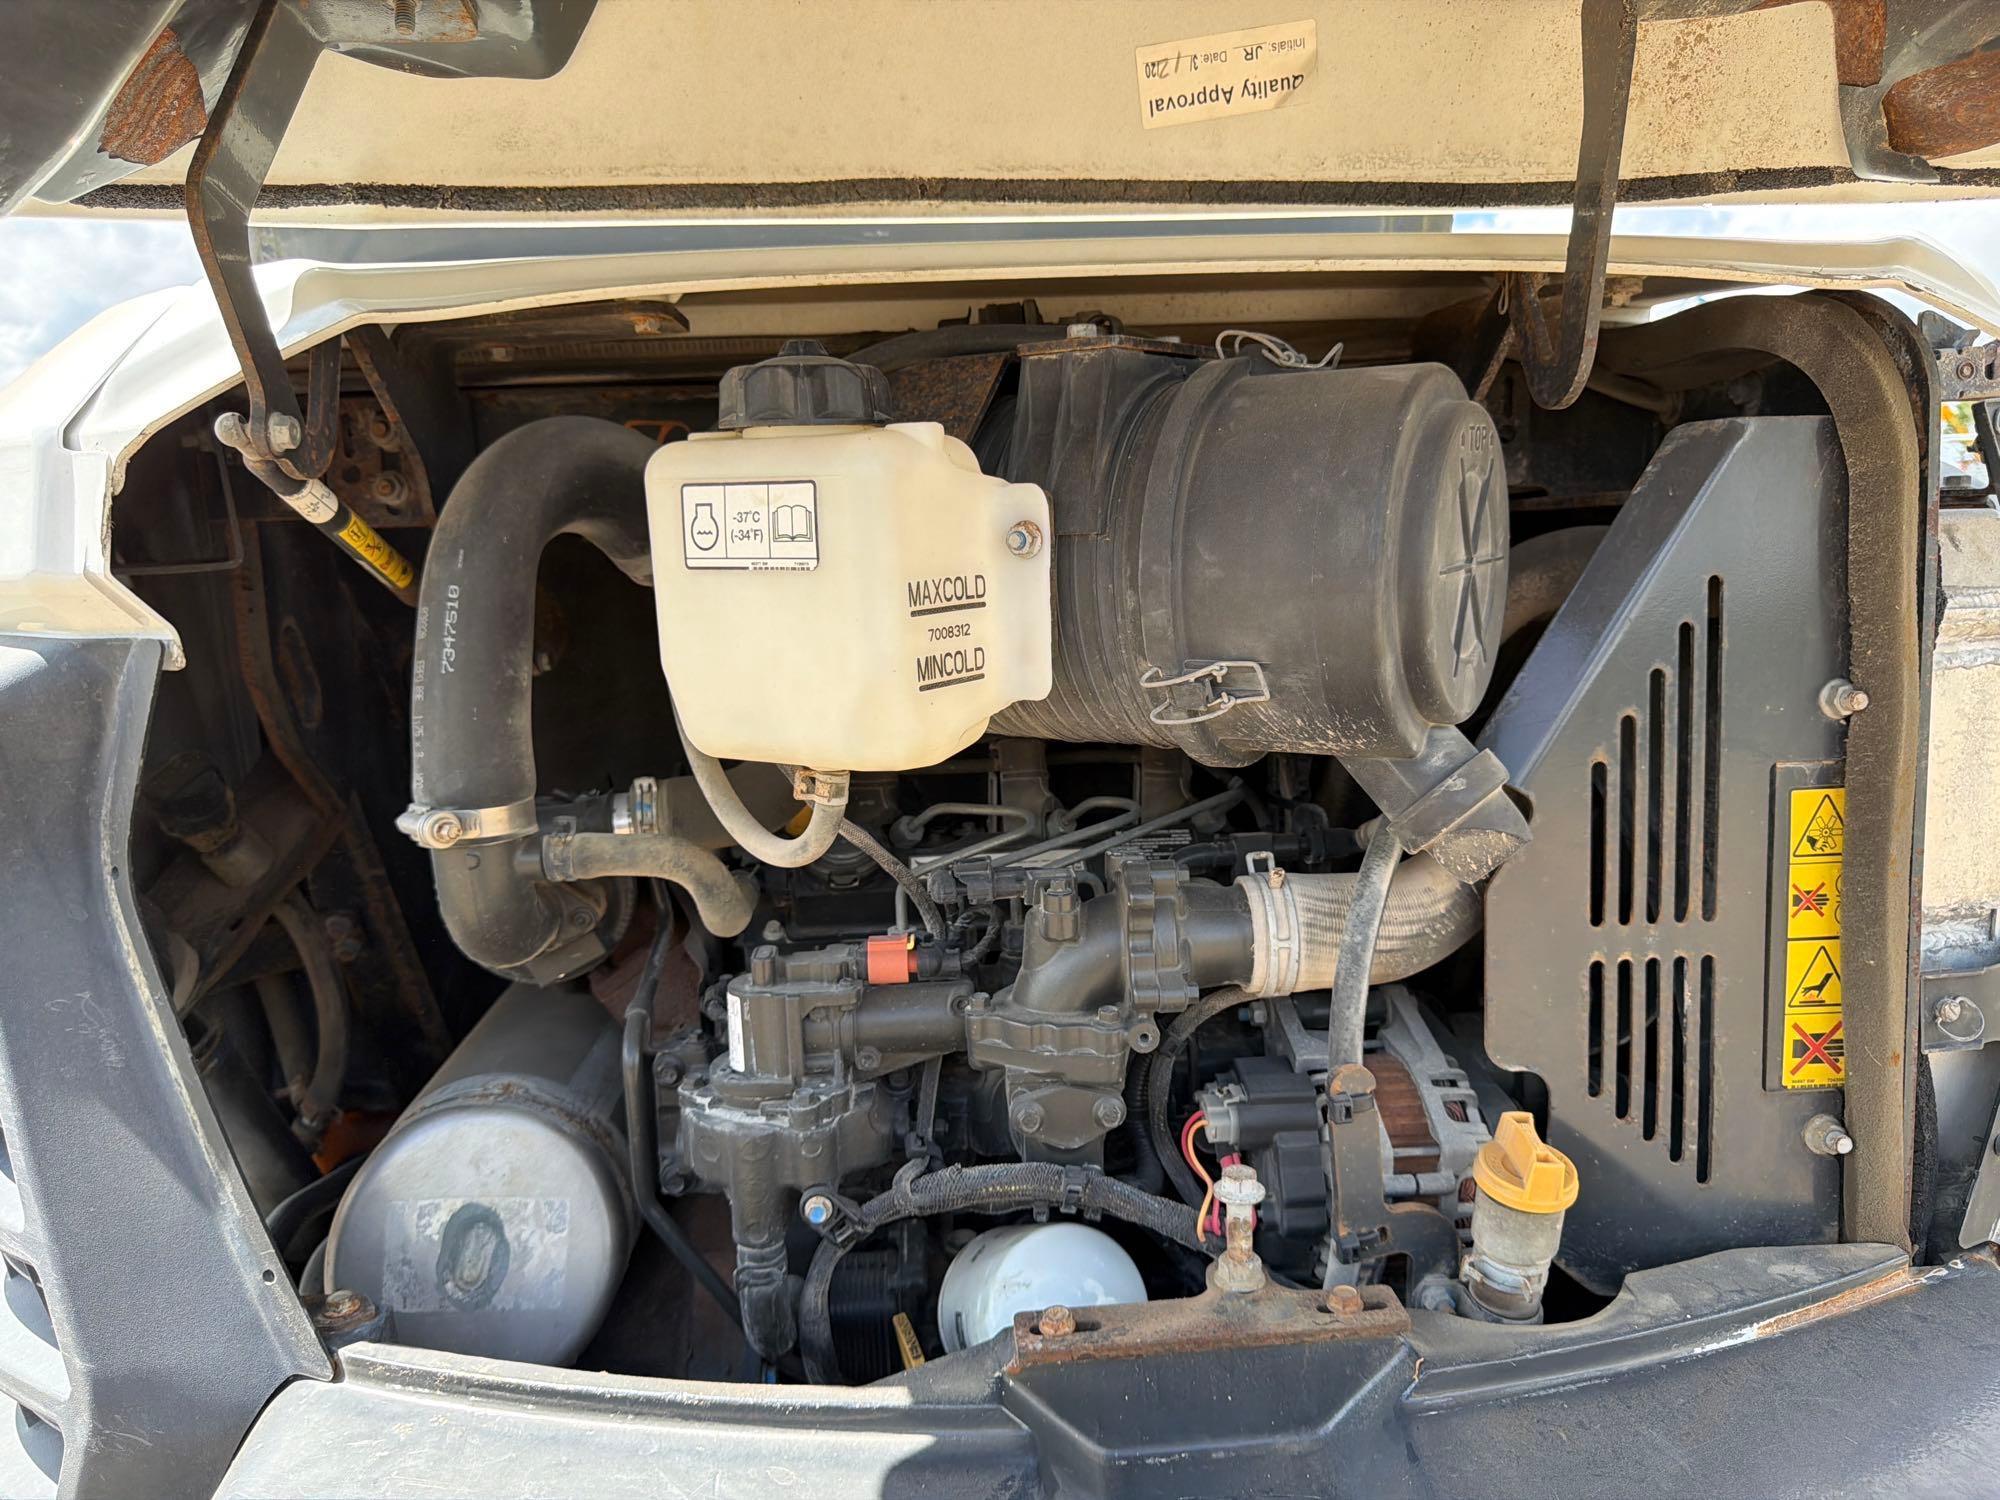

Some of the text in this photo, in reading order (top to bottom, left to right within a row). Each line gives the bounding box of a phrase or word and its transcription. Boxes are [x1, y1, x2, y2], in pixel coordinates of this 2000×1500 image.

[1200, 50, 1228, 64] Date:
[1244, 45, 1263, 62] JR
[1149, 74, 1304, 118] Quality Approval
[1468, 423, 1487, 453] TOP
[732, 511, 761, 523] -37°C
[730, 528, 764, 544] (-34°F)
[908, 574, 986, 607] MAXCOLD
[441, 584, 460, 674] 7347510
[927, 623, 971, 642] 7008312
[917, 646, 985, 682] MINCOLD
